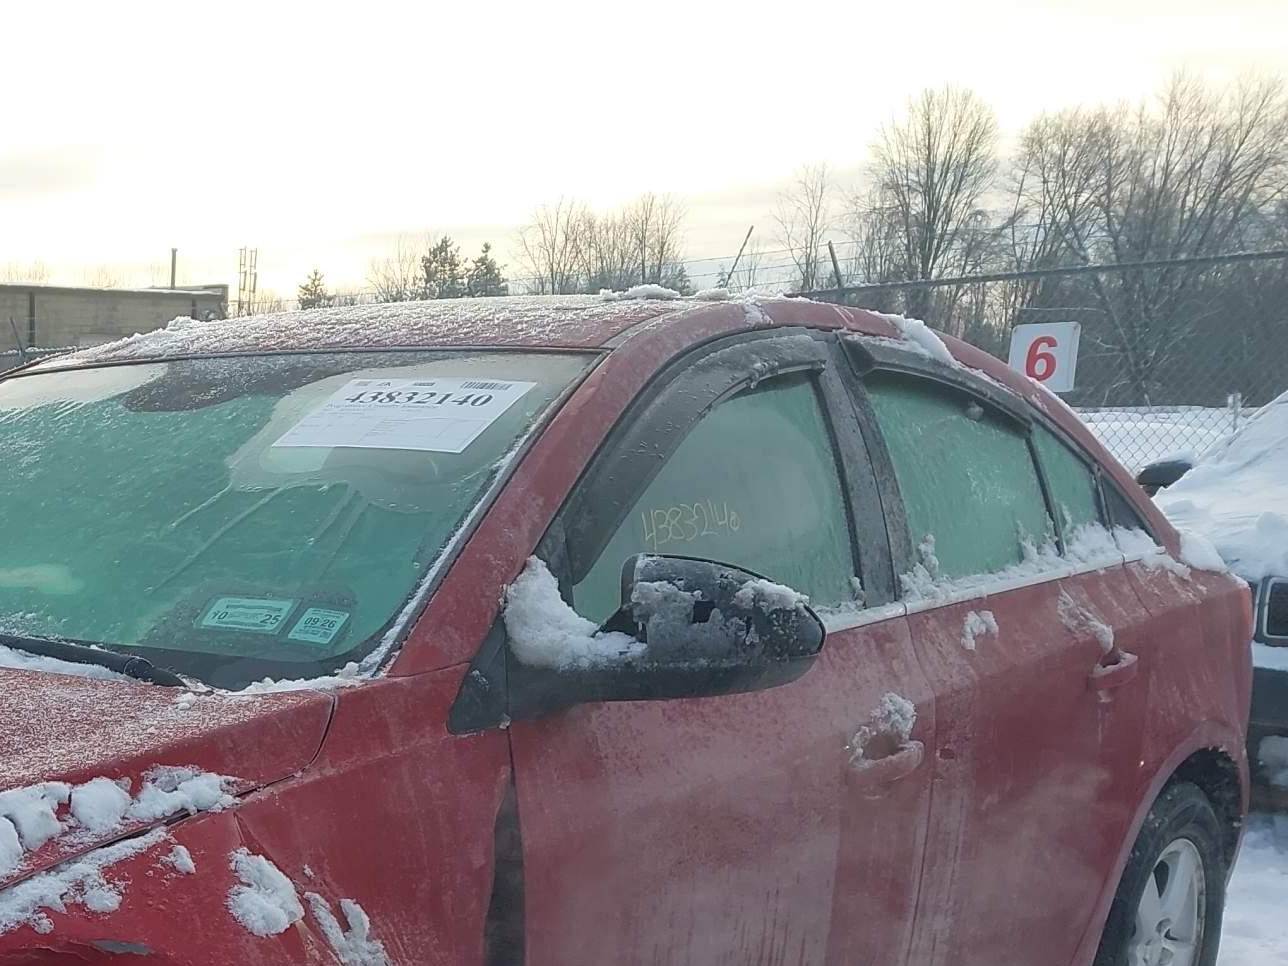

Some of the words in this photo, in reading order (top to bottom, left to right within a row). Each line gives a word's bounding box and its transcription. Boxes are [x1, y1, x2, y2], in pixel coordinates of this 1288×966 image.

[1026, 336, 1058, 382] 6
[344, 391, 494, 406] 43832140
[641, 499, 741, 553] 43832140
[259, 613, 282, 625] 25
